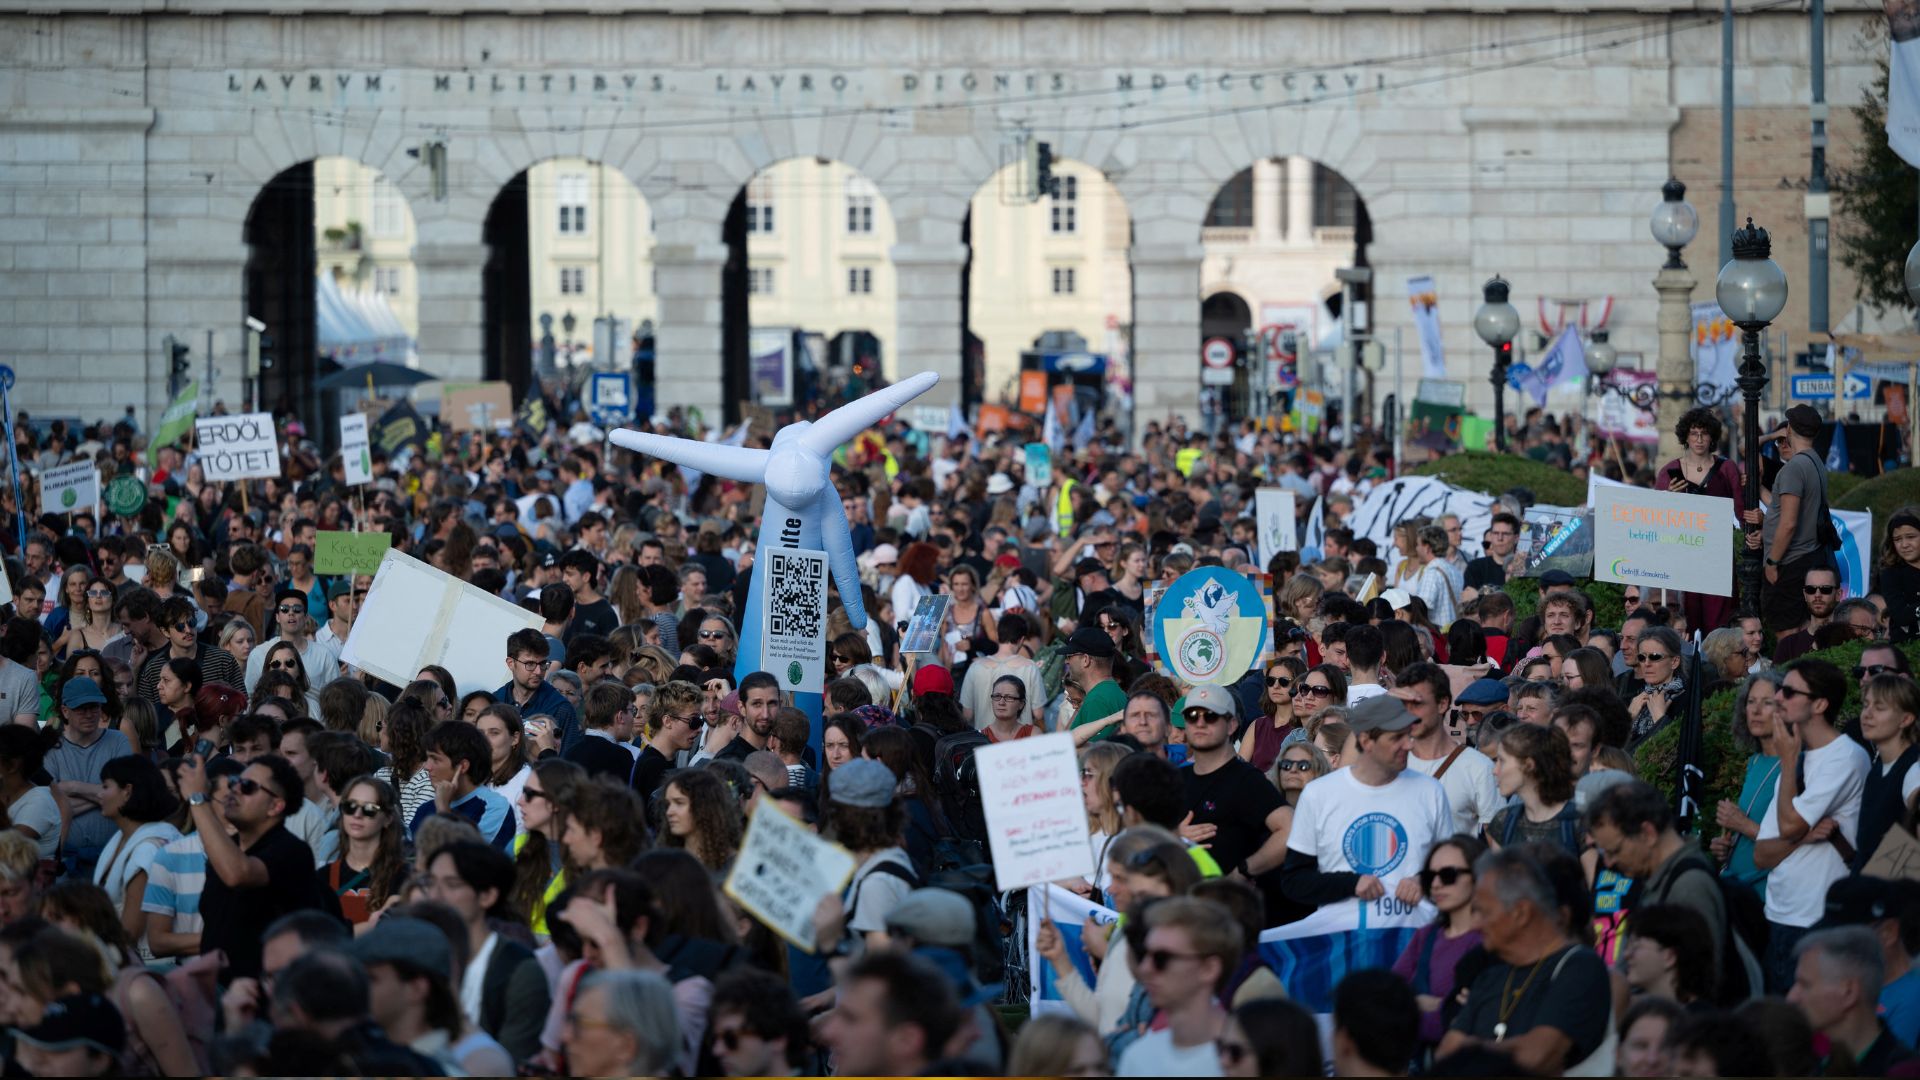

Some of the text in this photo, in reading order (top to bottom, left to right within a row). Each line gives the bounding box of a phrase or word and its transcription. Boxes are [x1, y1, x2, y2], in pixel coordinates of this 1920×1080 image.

[1799, 381, 1836, 394] EINBA
[197, 417, 270, 446] ERDÖL
[200, 447, 273, 475] TÖTET
[1611, 503, 1713, 532] DEMOKRATIE
[1546, 531, 1569, 554] worth
[1629, 527, 1658, 543] betrifft
[1188, 633, 1200, 642] FOR
[1201, 632, 1220, 648] FUTURE
[1343, 814, 1399, 868] SCIENTISTS FOR FUTURE
[1374, 896, 1414, 917] 1900
